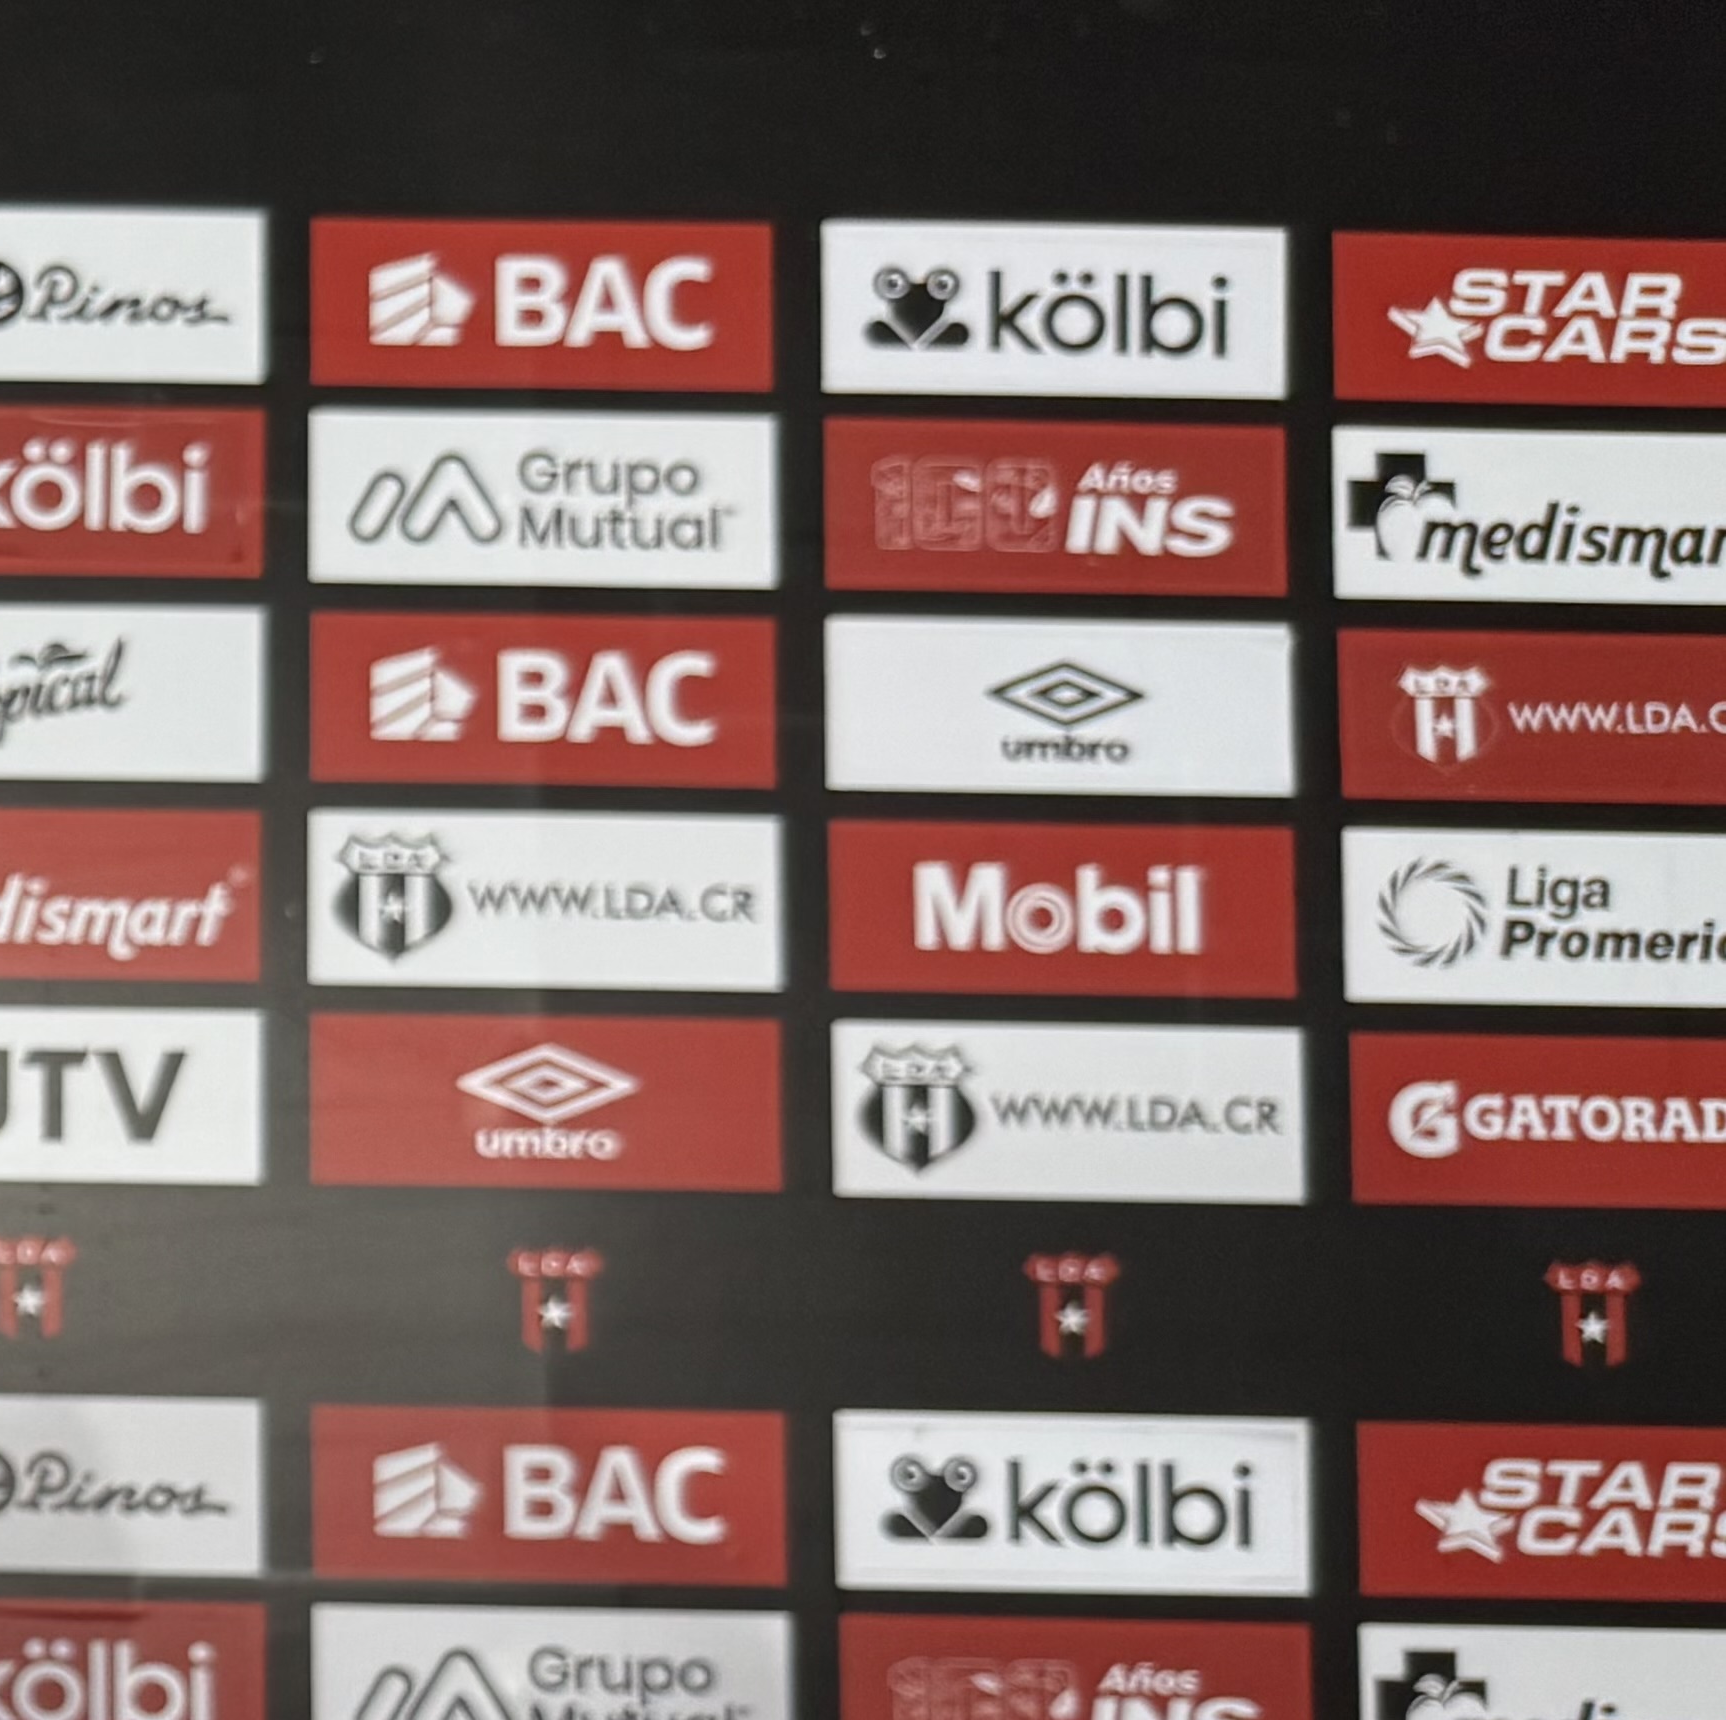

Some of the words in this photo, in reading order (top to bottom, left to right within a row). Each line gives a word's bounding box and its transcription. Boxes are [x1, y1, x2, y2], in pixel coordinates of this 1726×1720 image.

[23, 263, 230, 326] Pinos
[496, 256, 711, 350] BAC
[990, 270, 1228, 358] kölbi
[1443, 269, 1682, 325] STAR
[1485, 313, 1726, 364] CARS
[518, 449, 702, 511] Grupo
[1078, 463, 1177, 495] Años
[519, 504, 727, 550] Mutual
[1067, 495, 1233, 556] INS
[498, 649, 715, 745] BAC
[1001, 734, 1131, 763] umbro
[468, 882, 756, 922] WWW.LDA.CR
[914, 862, 1201, 954] Mobil
[1507, 866, 1610, 921] Liga
[475, 1119, 620, 1159] umbro
[992, 1095, 1280, 1135] WWW.LDA.CR
[15, 1449, 230, 1516] Pinos
[505, 1445, 724, 1543] BAC
[1008, 1459, 1252, 1549] kölbi
[1479, 1459, 1722, 1517] STAR
[1517, 1505, 1726, 1557] CAR
[528, 1646, 720, 1712] Grupo
[1099, 1663, 1199, 1696] Años
